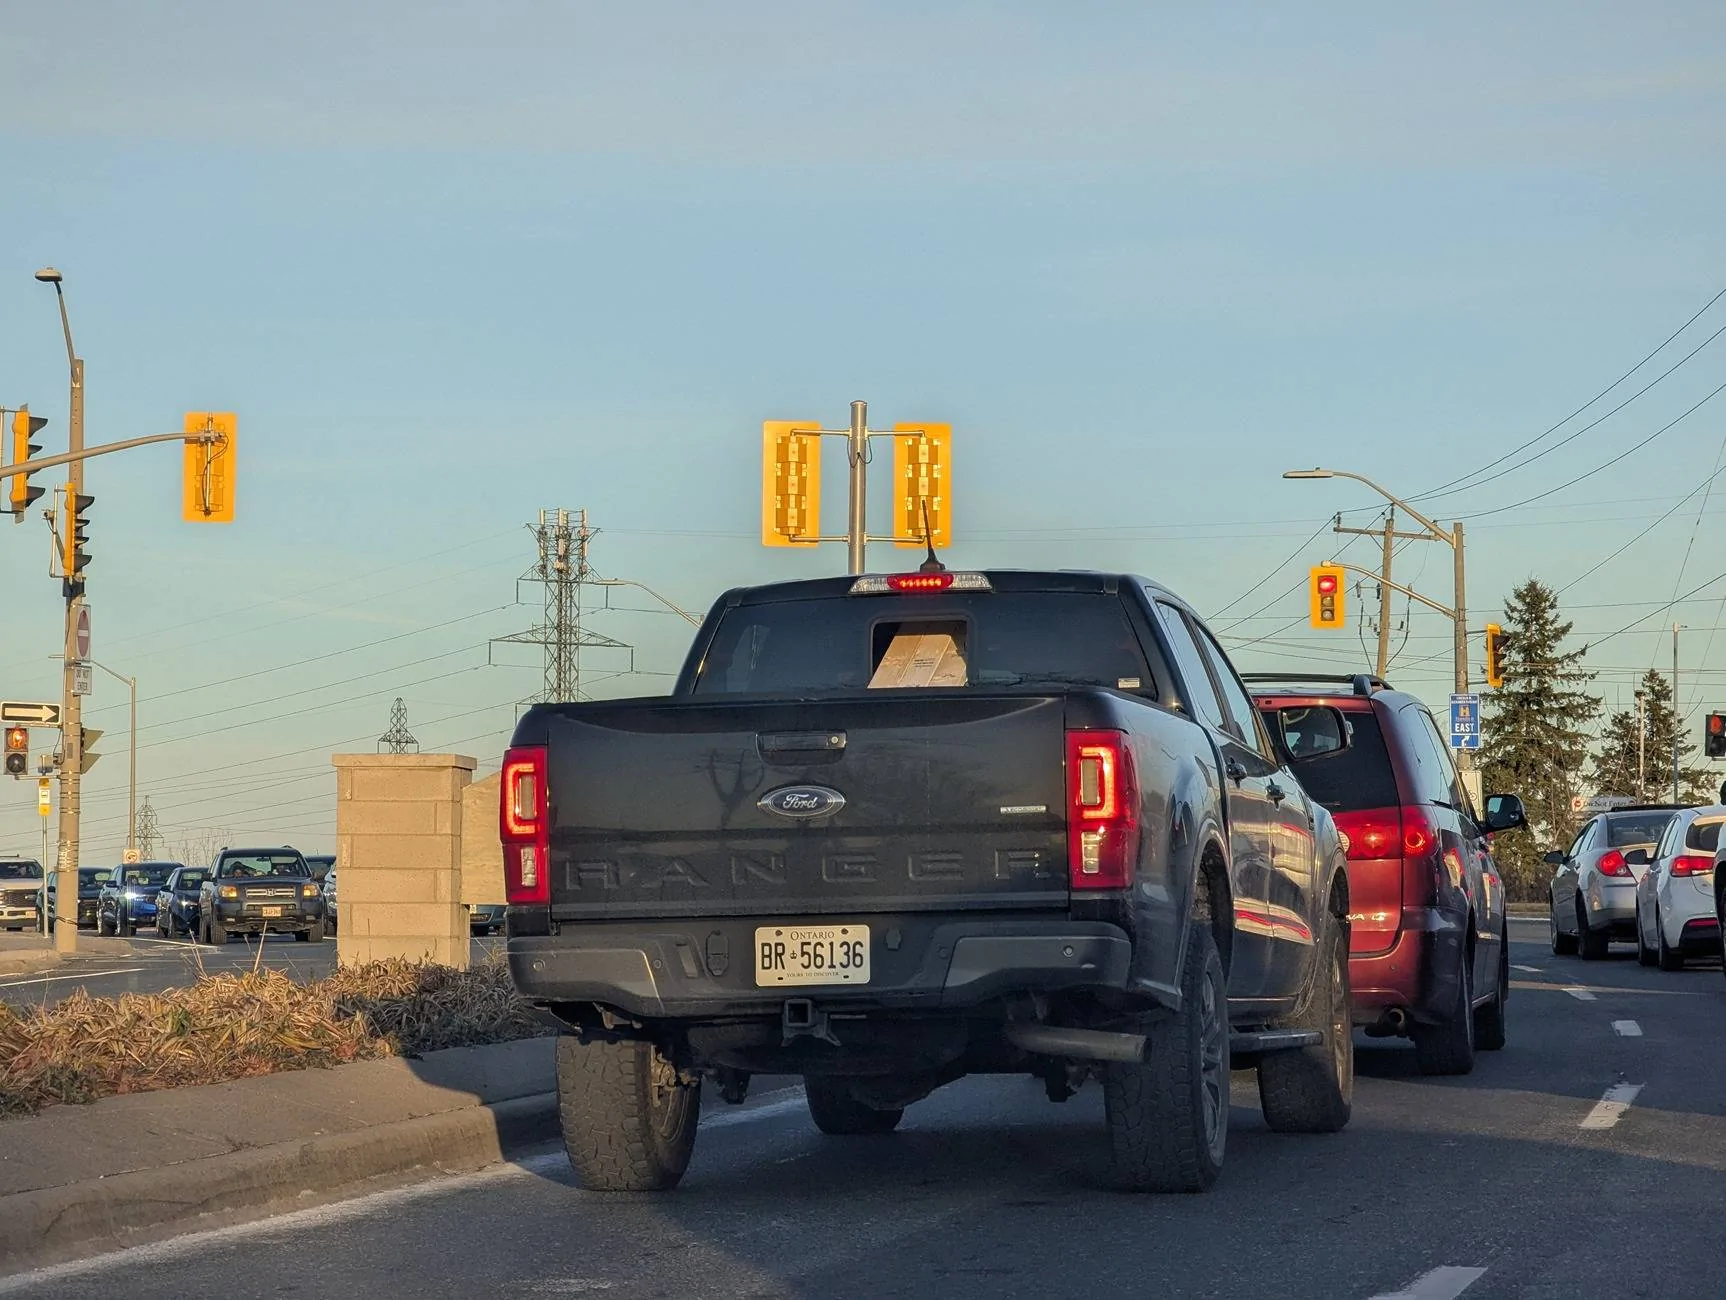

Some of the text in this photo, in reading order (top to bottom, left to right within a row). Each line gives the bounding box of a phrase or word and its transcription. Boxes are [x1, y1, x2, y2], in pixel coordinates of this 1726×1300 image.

[1455, 722, 1475, 733] EAST
[782, 793, 818, 809] Ford
[565, 846, 1051, 892] RANGER
[790, 930, 835, 941] ONTARIO
[760, 940, 864, 970] BR 56136
